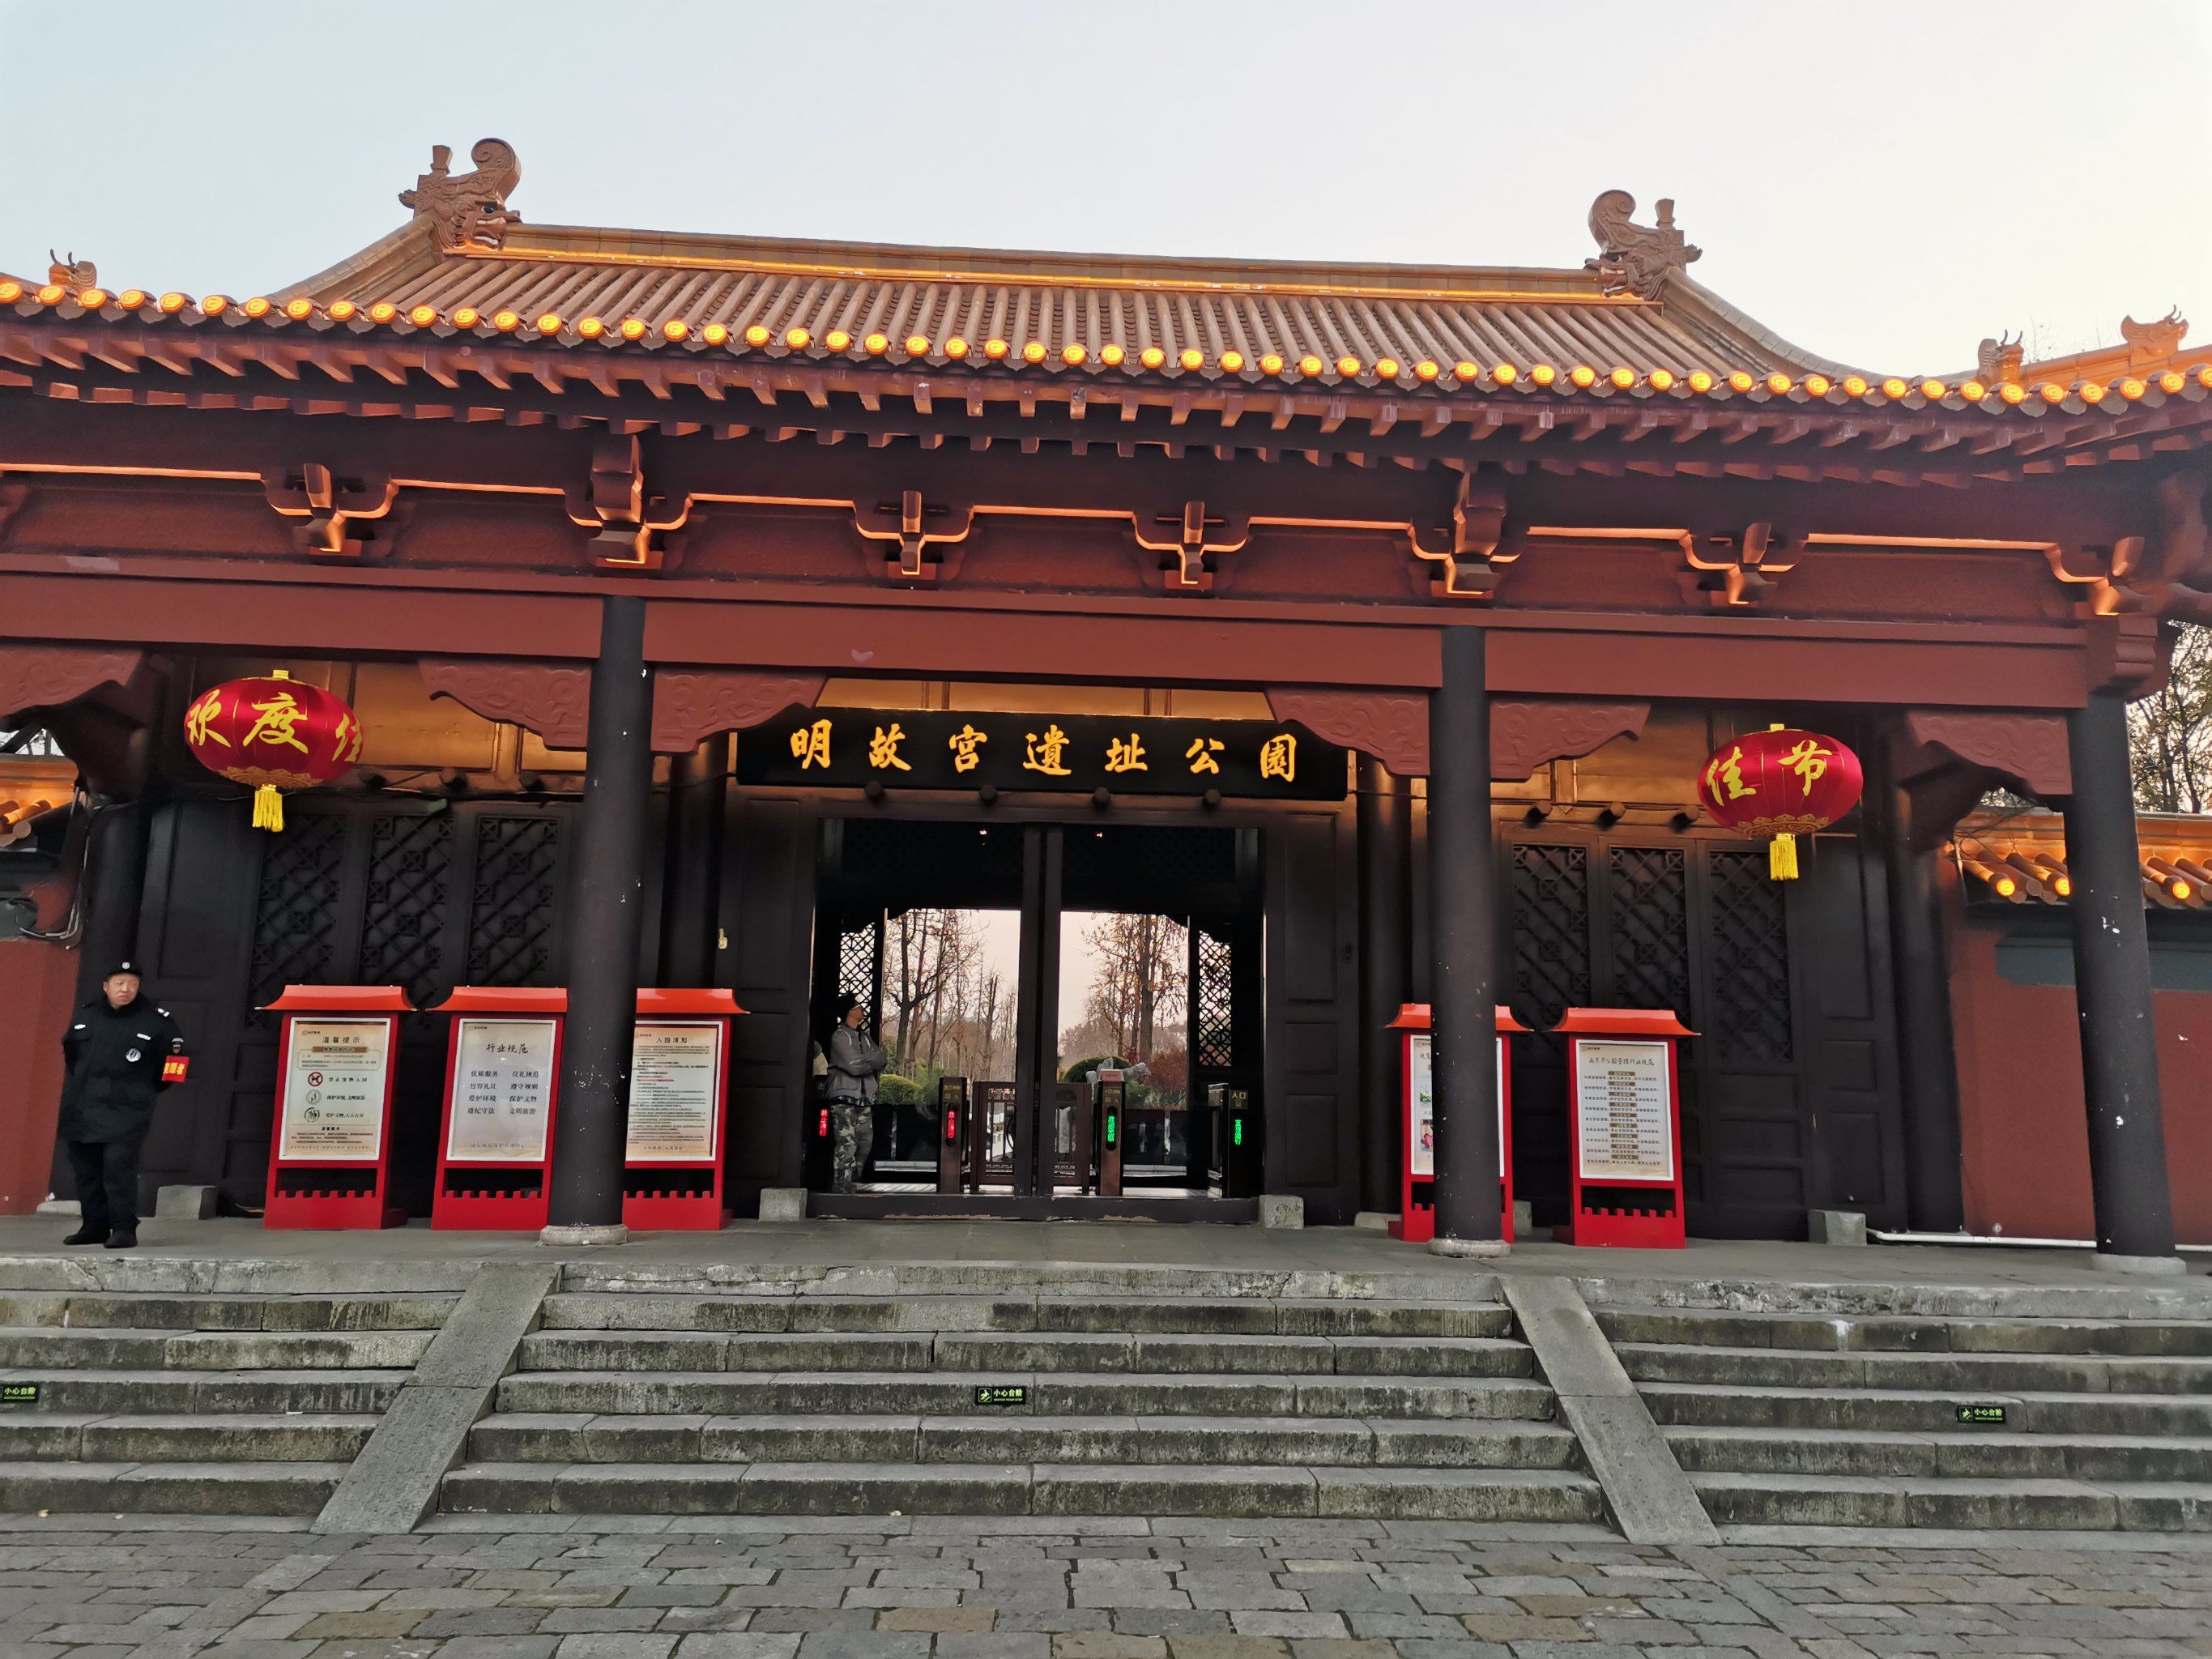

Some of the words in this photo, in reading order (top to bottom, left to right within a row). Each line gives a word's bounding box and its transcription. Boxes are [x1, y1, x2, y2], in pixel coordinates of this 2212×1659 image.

[1705, 740, 1833, 807] 佳节
[322, 1036, 361, 1044] 温馨提示
[486, 1043, 529, 1054] 行业规范
[1232, 1091, 1247, 1099] 入口
[4, 1387, 36, 1395] 小心台阶
[993, 1388, 1023, 1397] 小心台阶
